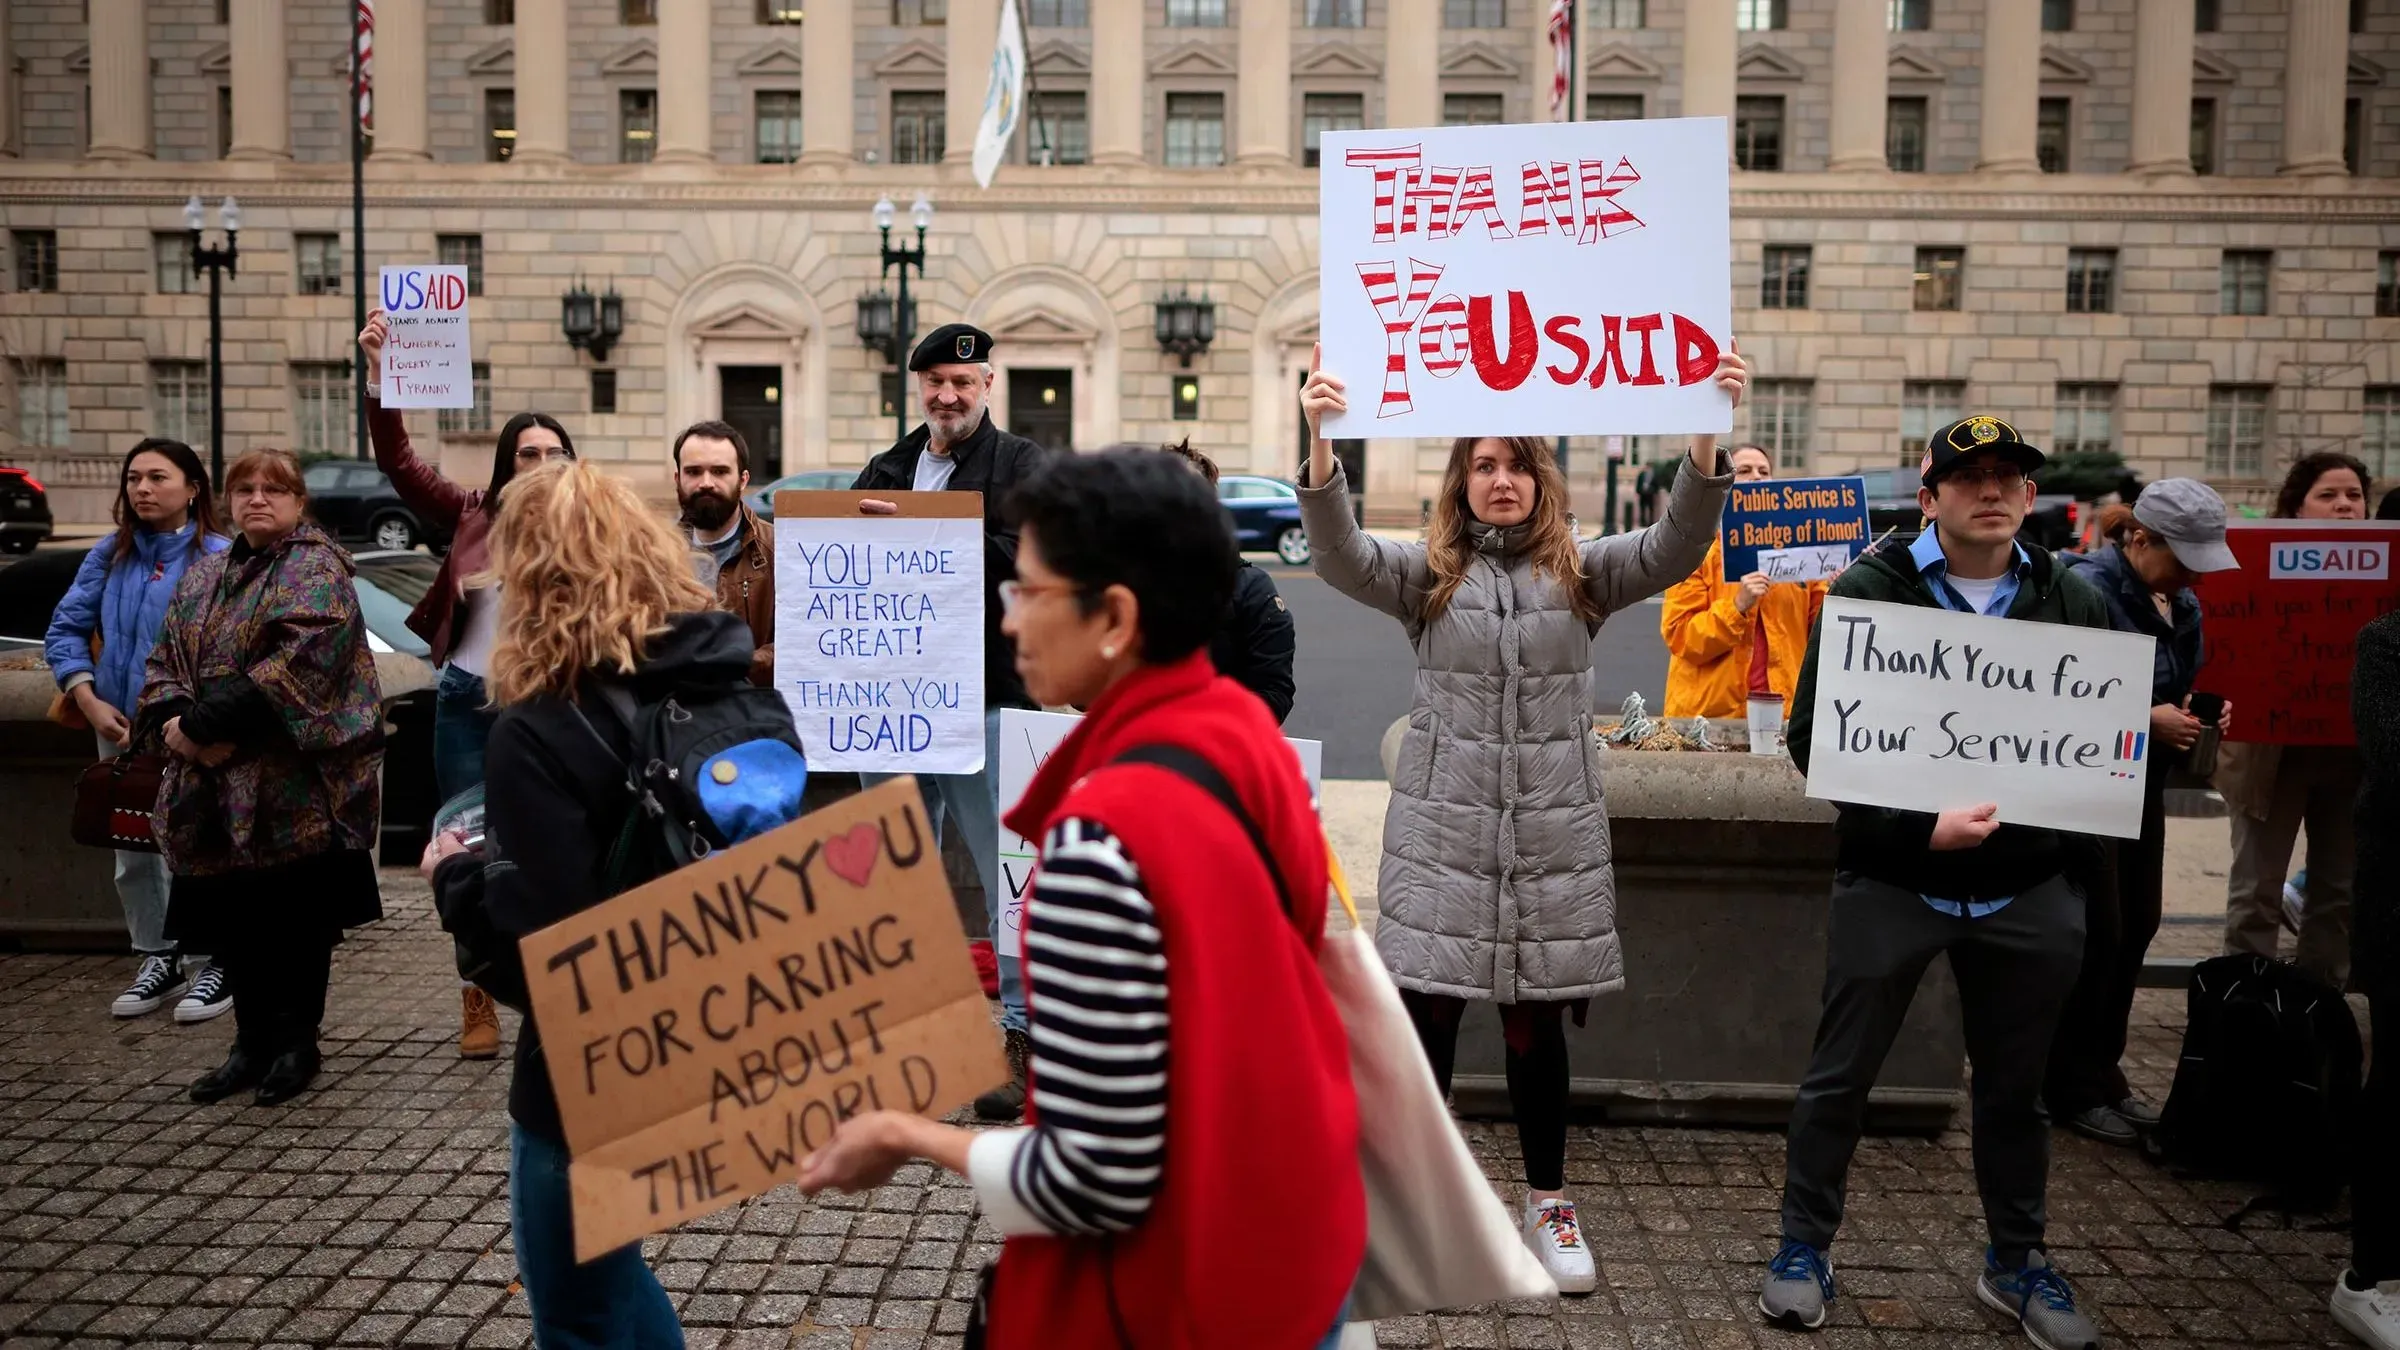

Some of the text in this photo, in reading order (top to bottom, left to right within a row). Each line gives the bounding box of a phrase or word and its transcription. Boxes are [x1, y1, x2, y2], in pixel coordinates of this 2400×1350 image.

[1345, 142, 1646, 245] THANK
[383, 271, 466, 312] USAID
[386, 316, 460, 328] STANDS AGAINST
[389, 375, 451, 396] TYRANNY
[1732, 484, 1856, 513] Public Service is
[1729, 516, 1864, 549] a Badge of Honor!
[798, 542, 955, 586] YOU MADE
[1767, 553, 1807, 580] Thank
[2277, 548, 2381, 572] USAID
[807, 592, 937, 622] AMERICA
[818, 626, 923, 658] GREAT!
[1838, 615, 2122, 700] Thank You for
[796, 677, 959, 709] THANK YOU
[829, 714, 932, 753] USAID
[1833, 699, 1916, 753] Your
[583, 914, 915, 1096] FOR CARING
[708, 1000, 885, 1124] ABOUT
[631, 1139, 739, 1216] THE
